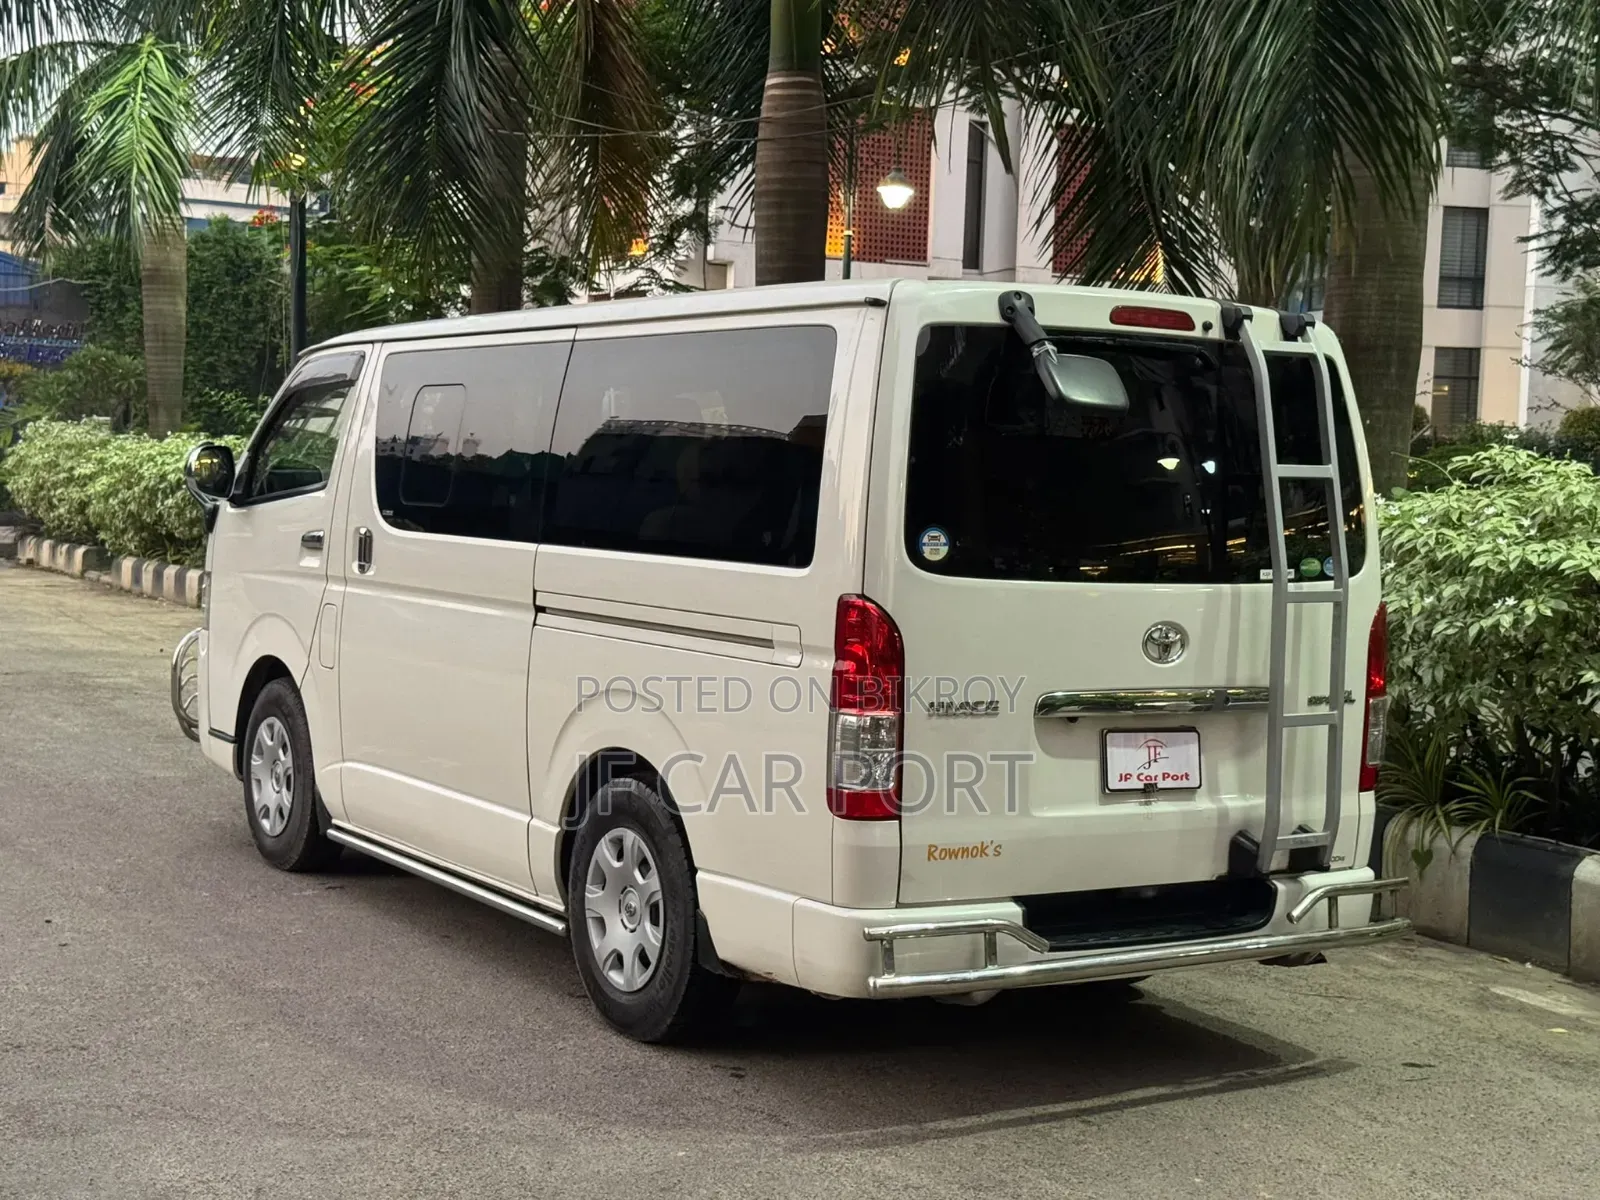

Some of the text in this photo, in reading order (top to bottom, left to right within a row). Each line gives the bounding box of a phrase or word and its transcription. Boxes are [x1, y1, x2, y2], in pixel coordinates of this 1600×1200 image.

[1118, 772, 1190, 782] JF Car Port
[927, 840, 1002, 862] Rownok's
